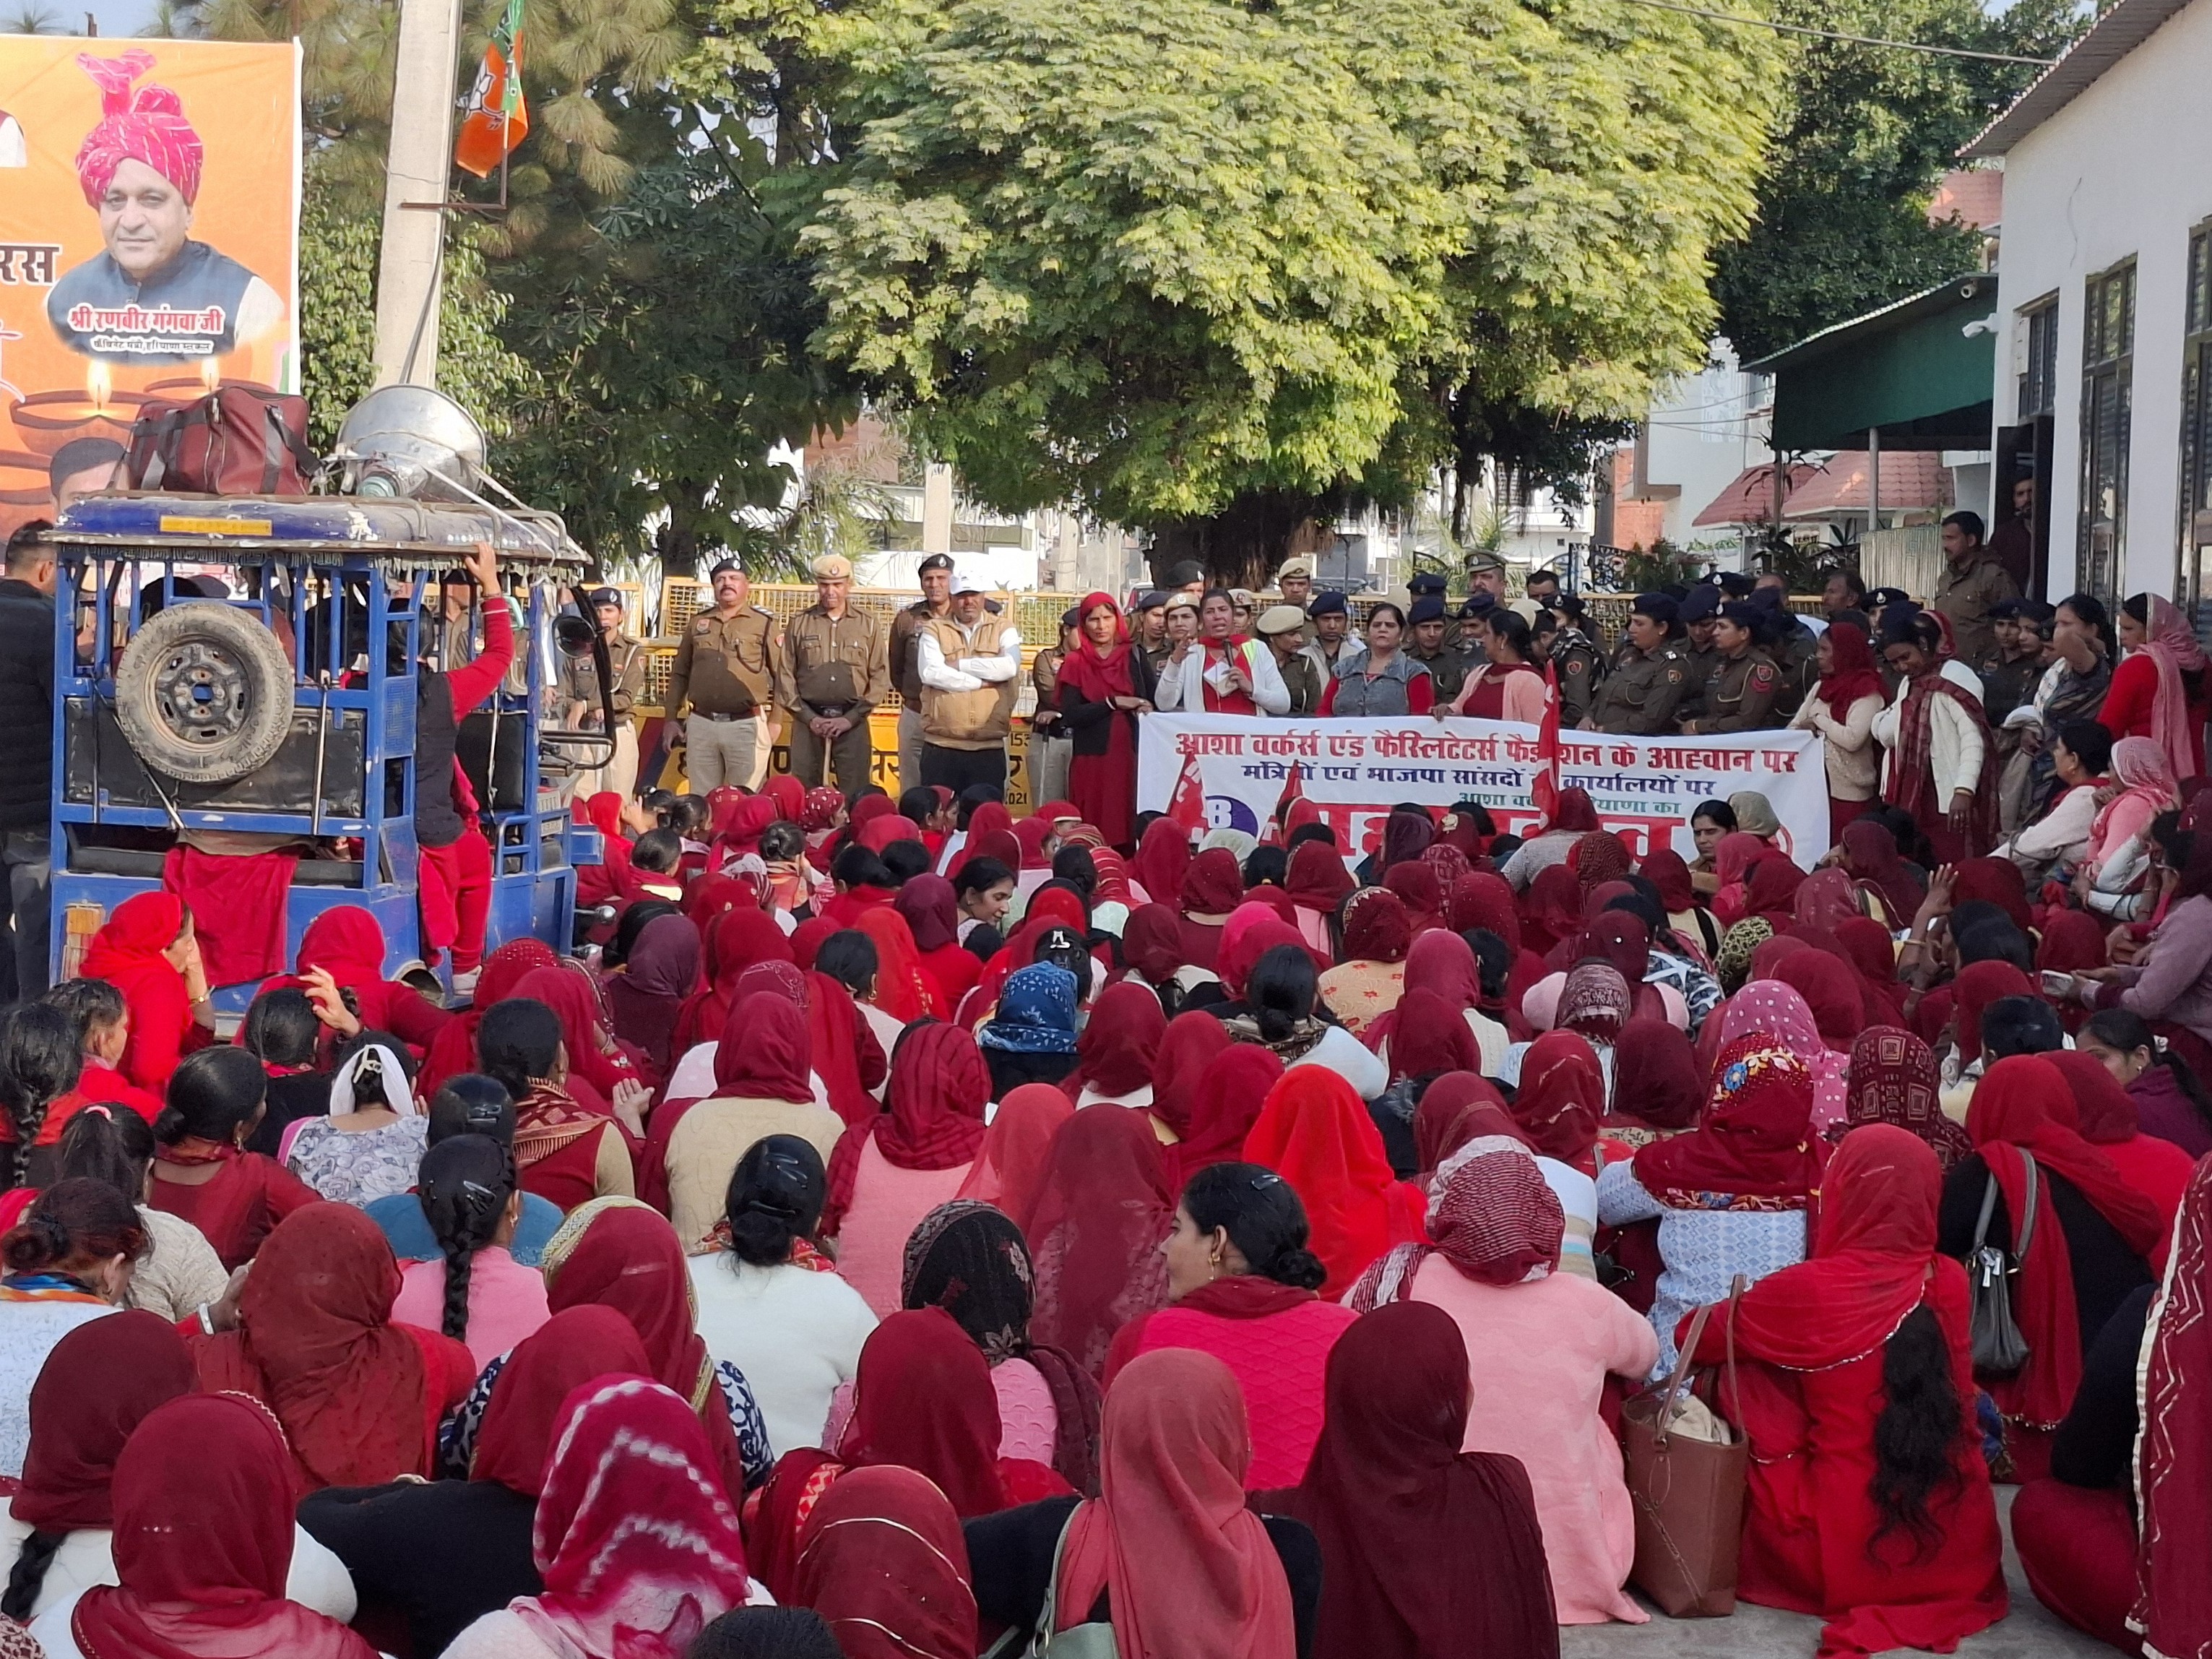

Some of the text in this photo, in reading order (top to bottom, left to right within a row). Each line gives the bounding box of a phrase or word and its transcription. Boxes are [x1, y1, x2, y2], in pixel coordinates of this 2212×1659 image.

[72, 306, 92, 328] श्री
[152, 306, 197, 330] गंगवा
[199, 309, 223, 331] जी
[1175, 733, 1245, 754] आशा
[1250, 729, 1321, 756] वर्कर्स
[1327, 731, 1367, 756] एंड
[1609, 742, 1638, 766] के
[1761, 750, 1799, 772] पर
[1321, 763, 1360, 780] एवं
[1367, 767, 1446, 783] भाजपा
[1451, 767, 1526, 787] सांसदों
[1561, 773, 1680, 793] कार्यालयों
[1684, 780, 1716, 795] पर
[1653, 801, 1682, 814] का
